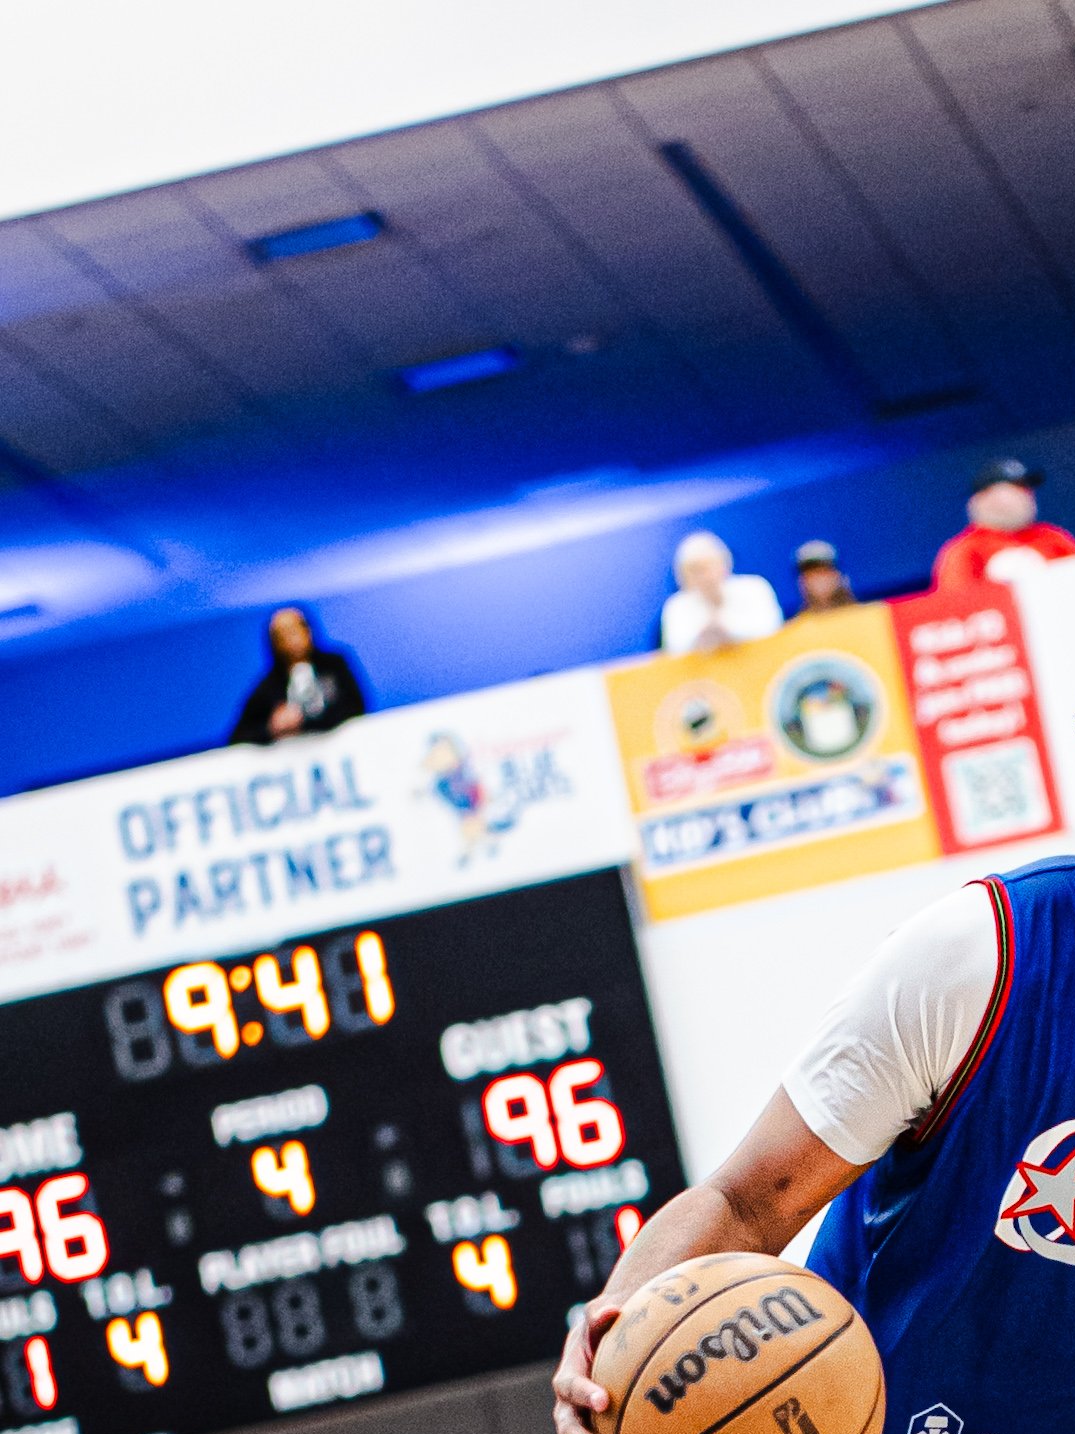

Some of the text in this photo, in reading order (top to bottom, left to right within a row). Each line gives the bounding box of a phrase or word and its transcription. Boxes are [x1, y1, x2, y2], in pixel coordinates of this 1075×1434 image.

[118, 754, 376, 862] OFFICIAL
[126, 827, 394, 938] PARTNER
[163, 930, 395, 1059] 9:41
[440, 998, 593, 1081] GUEST
[483, 1057, 626, 1171] 96
[250, 1139, 316, 1216] 4
[452, 1234, 517, 1310] 4
[24, 1334, 59, 1411] 1
[105, 1310, 170, 1387] 4
[644, 1285, 824, 1415] Wilson
